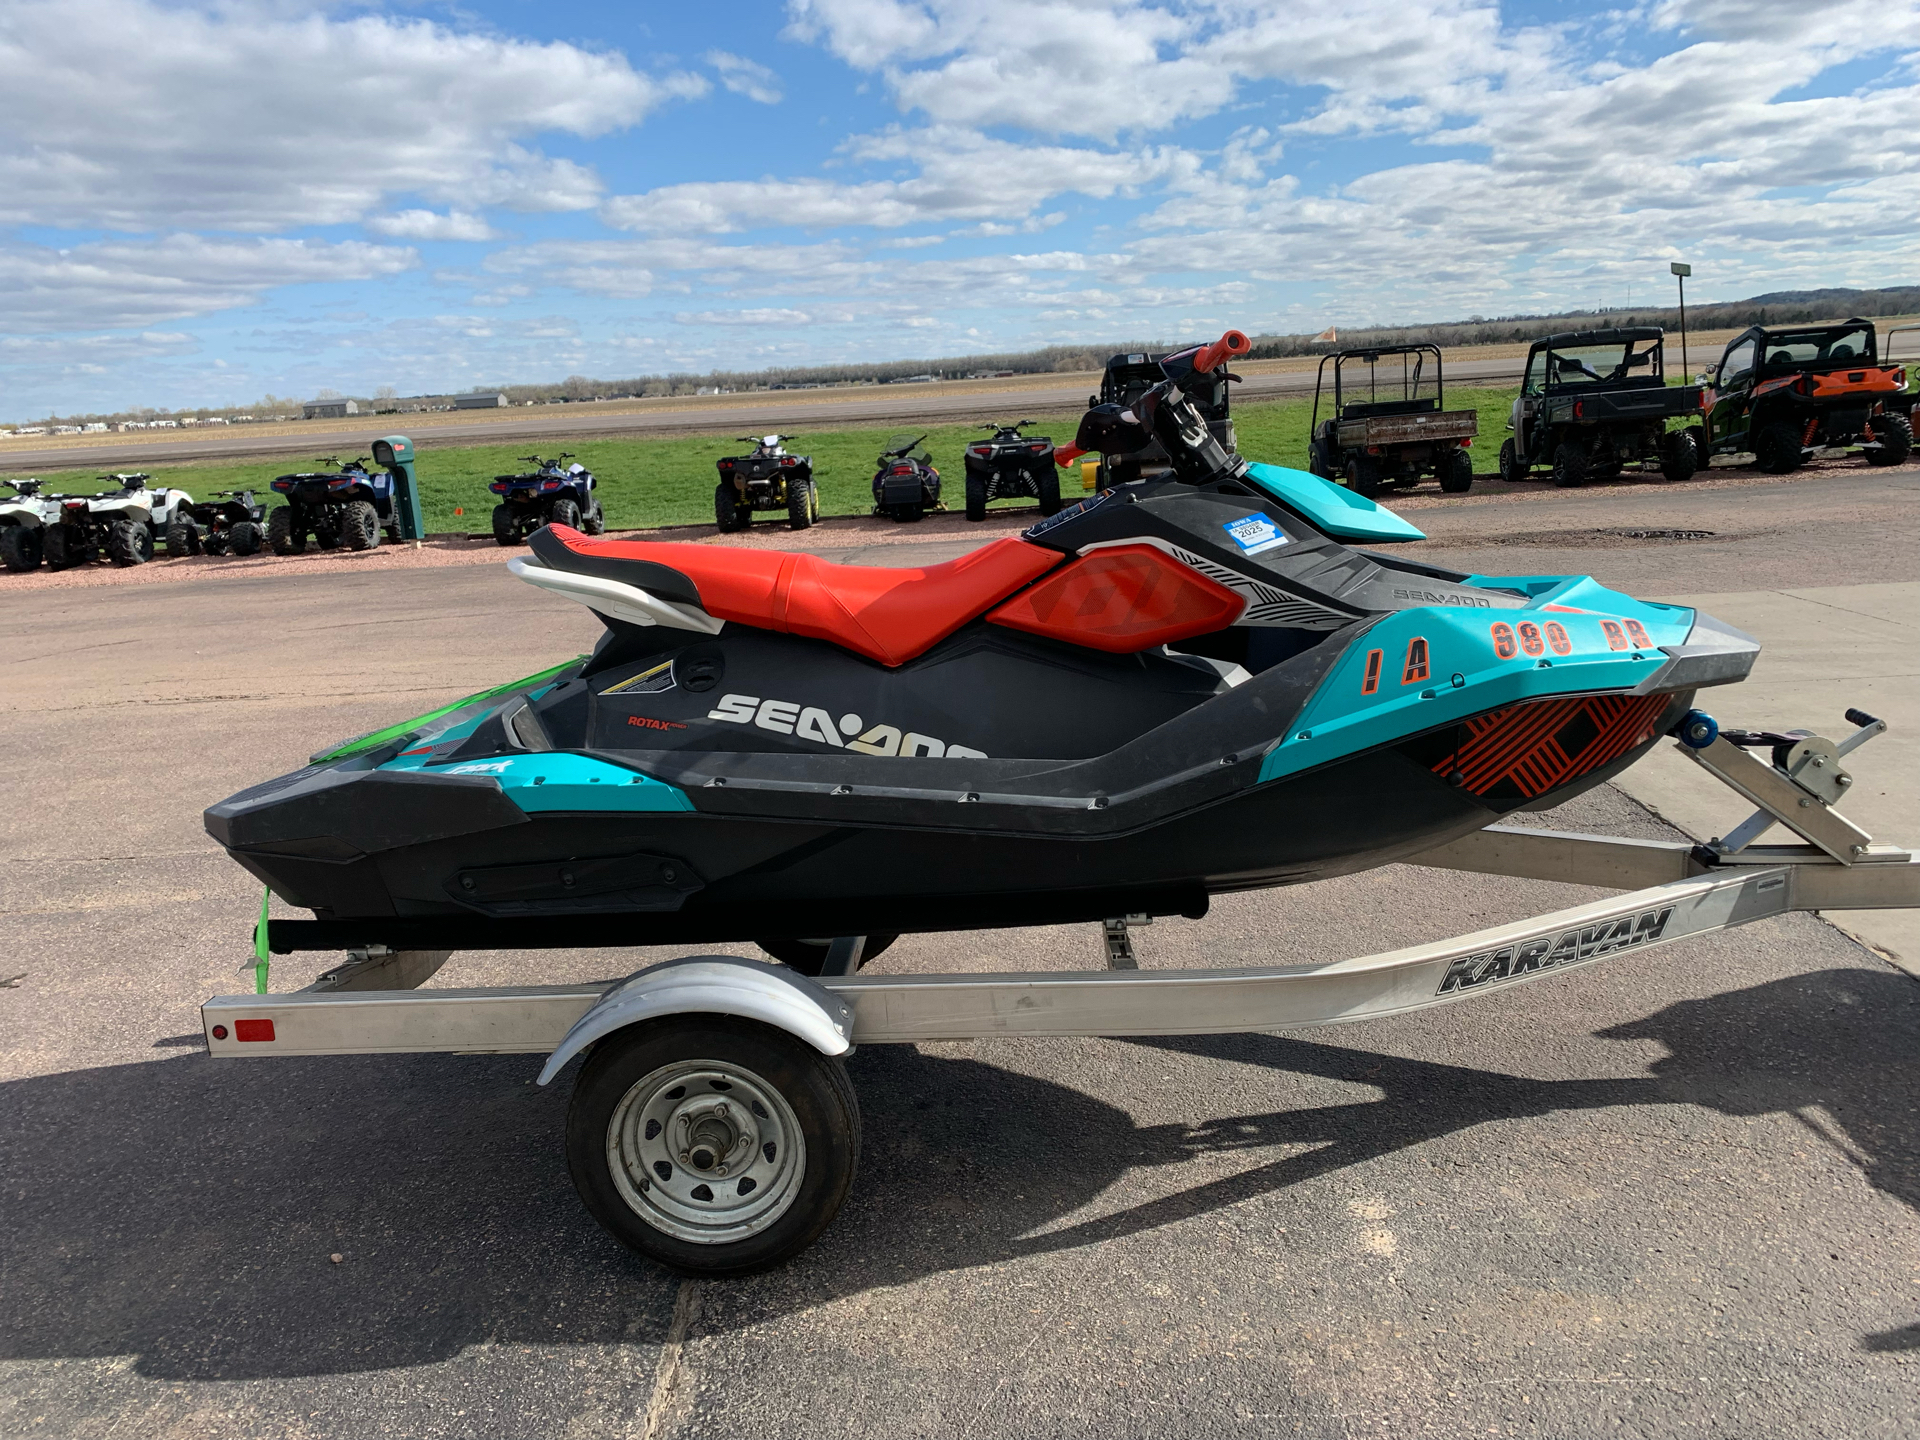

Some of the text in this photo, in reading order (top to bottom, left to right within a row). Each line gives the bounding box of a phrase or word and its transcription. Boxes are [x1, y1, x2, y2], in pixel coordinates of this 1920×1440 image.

[1231, 518, 1251, 527] IOWA
[1239, 525, 1263, 538] 2025
[1490, 621, 1572, 660] 980
[1599, 619, 1655, 651] BR
[628, 716, 670, 731] ROTAX
[1435, 905, 1676, 996] KARAVAN
